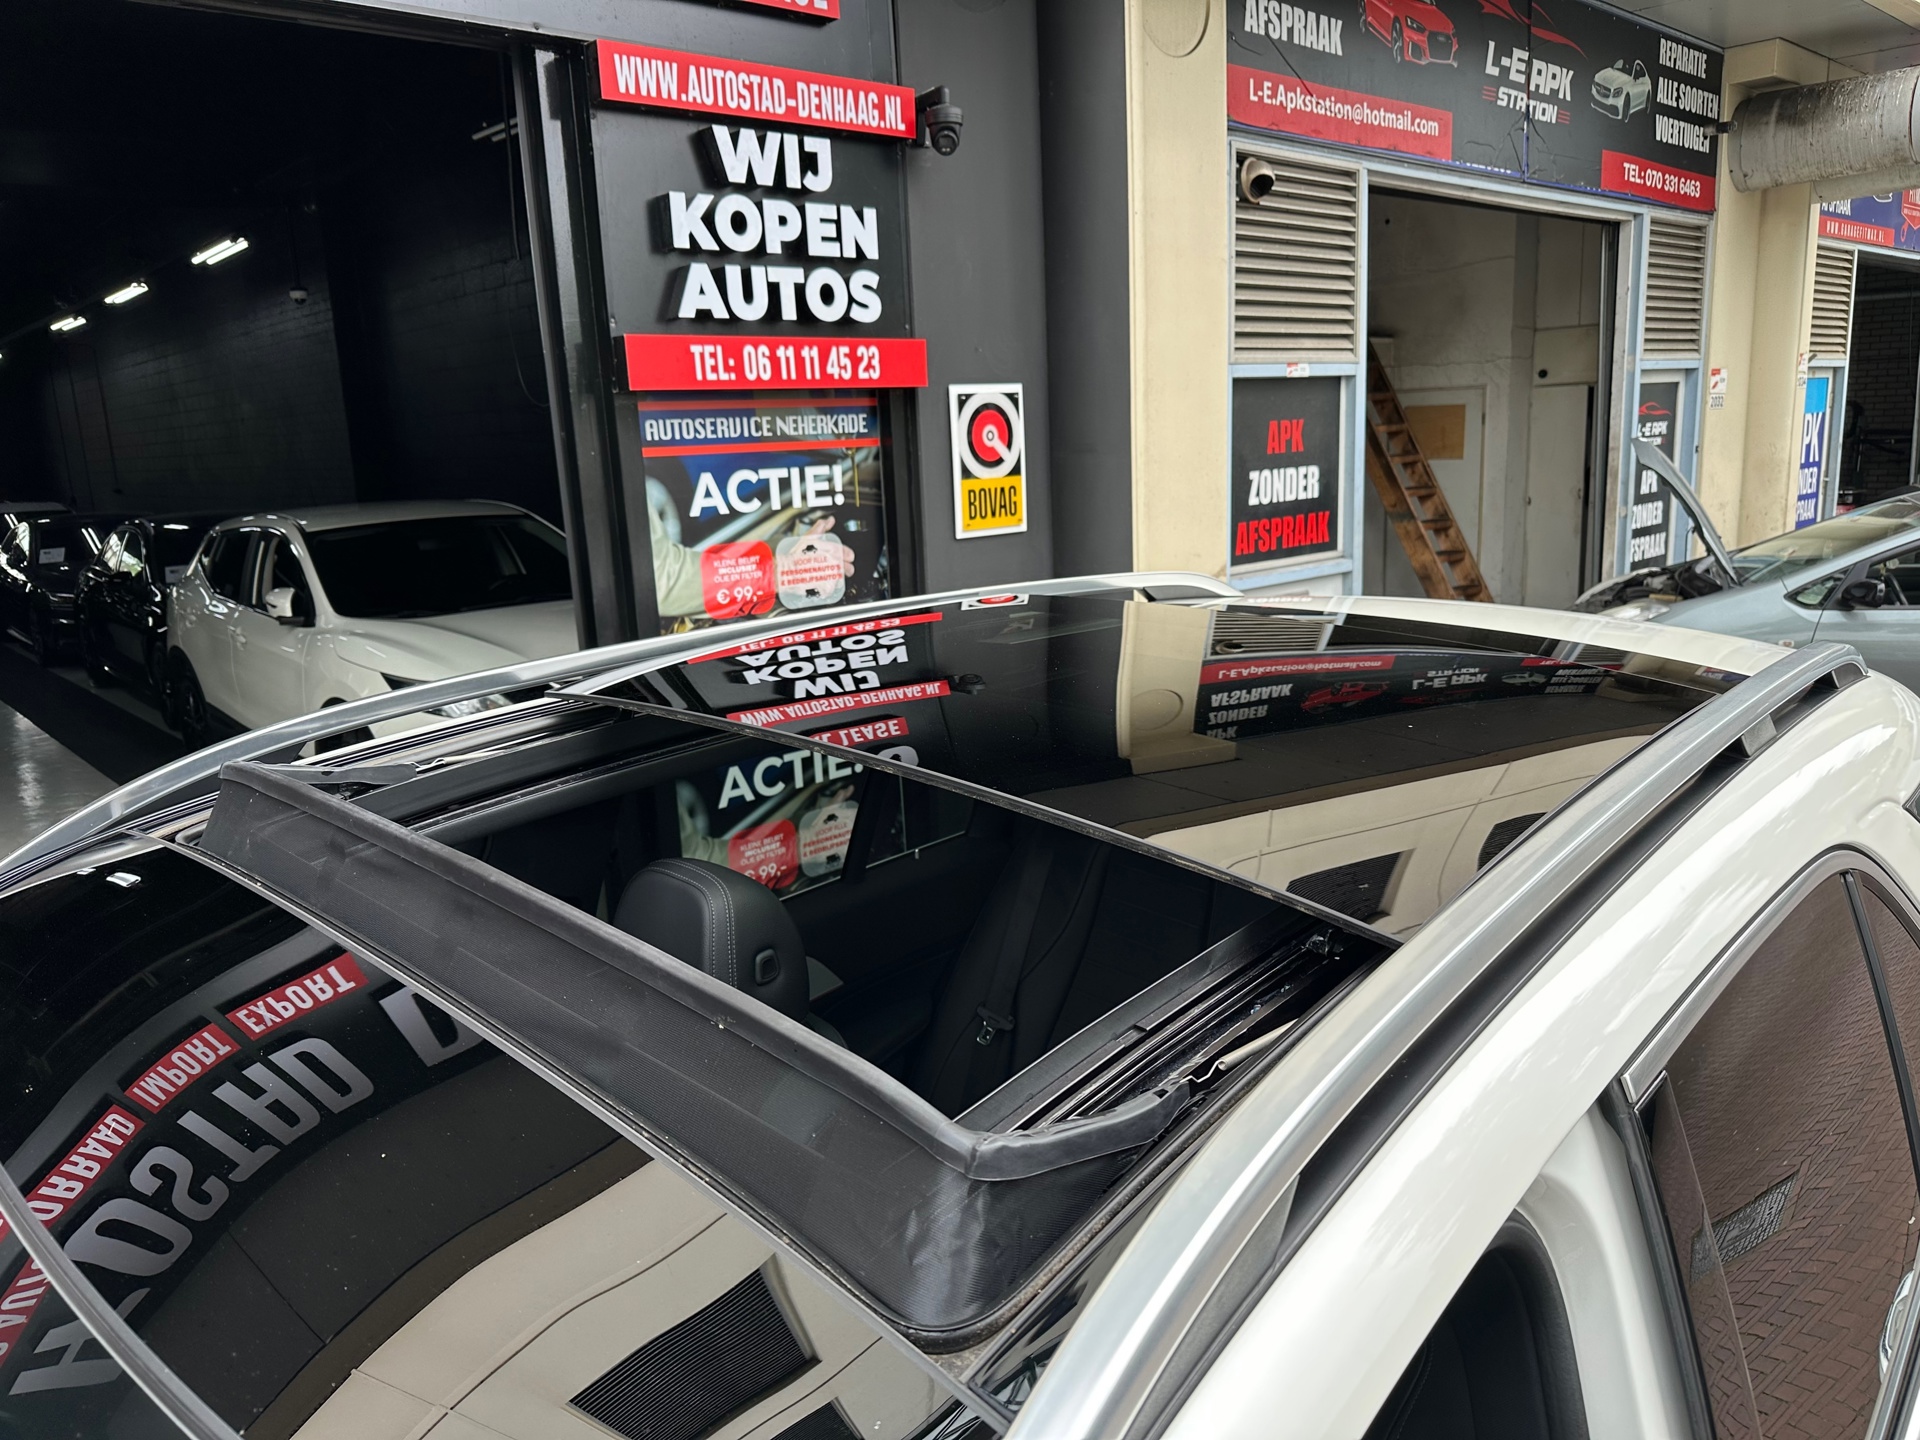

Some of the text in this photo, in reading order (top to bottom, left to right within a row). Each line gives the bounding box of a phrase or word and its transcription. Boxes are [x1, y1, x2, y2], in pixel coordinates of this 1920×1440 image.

[1244, 0, 1343, 56] AFSPRAAK
[1485, 40, 1574, 102] L-E APK
[1659, 37, 1707, 79] REPARATIE
[613, 53, 906, 131] WWW.AUTOSTAD-DENHAAG.NL
[1249, 78, 1439, 137] L-E.Apkstation@hotmail.com
[1497, 86, 1558, 124] STATION
[1656, 76, 1719, 120] ALLE SOORTEN
[711, 125, 833, 193] WIJ
[1623, 162, 1701, 198] TEL: 070 331 6463
[668, 190, 880, 260] KOPEN
[678, 262, 883, 324] AUTOS
[689, 344, 880, 381] TEL: 06 11 11 45 23
[645, 413, 868, 441] AUTOSERVICE NEHERKADE
[1266, 419, 1304, 455] APK
[1801, 412, 1823, 463] PK
[689, 464, 845, 518] ACTIE!
[1248, 464, 1320, 506] ZONDER
[1640, 469, 1658, 495] APK
[1797, 466, 1818, 496] NDER
[967, 485, 1018, 521] BOVAG
[1631, 500, 1663, 530] ZONDER
[1235, 511, 1331, 556] AFSPRAAK
[1630, 531, 1666, 563] FSPRAAK
[718, 564, 757, 574] INCLUSIEF
[716, 586, 764, 604] € 99,-
